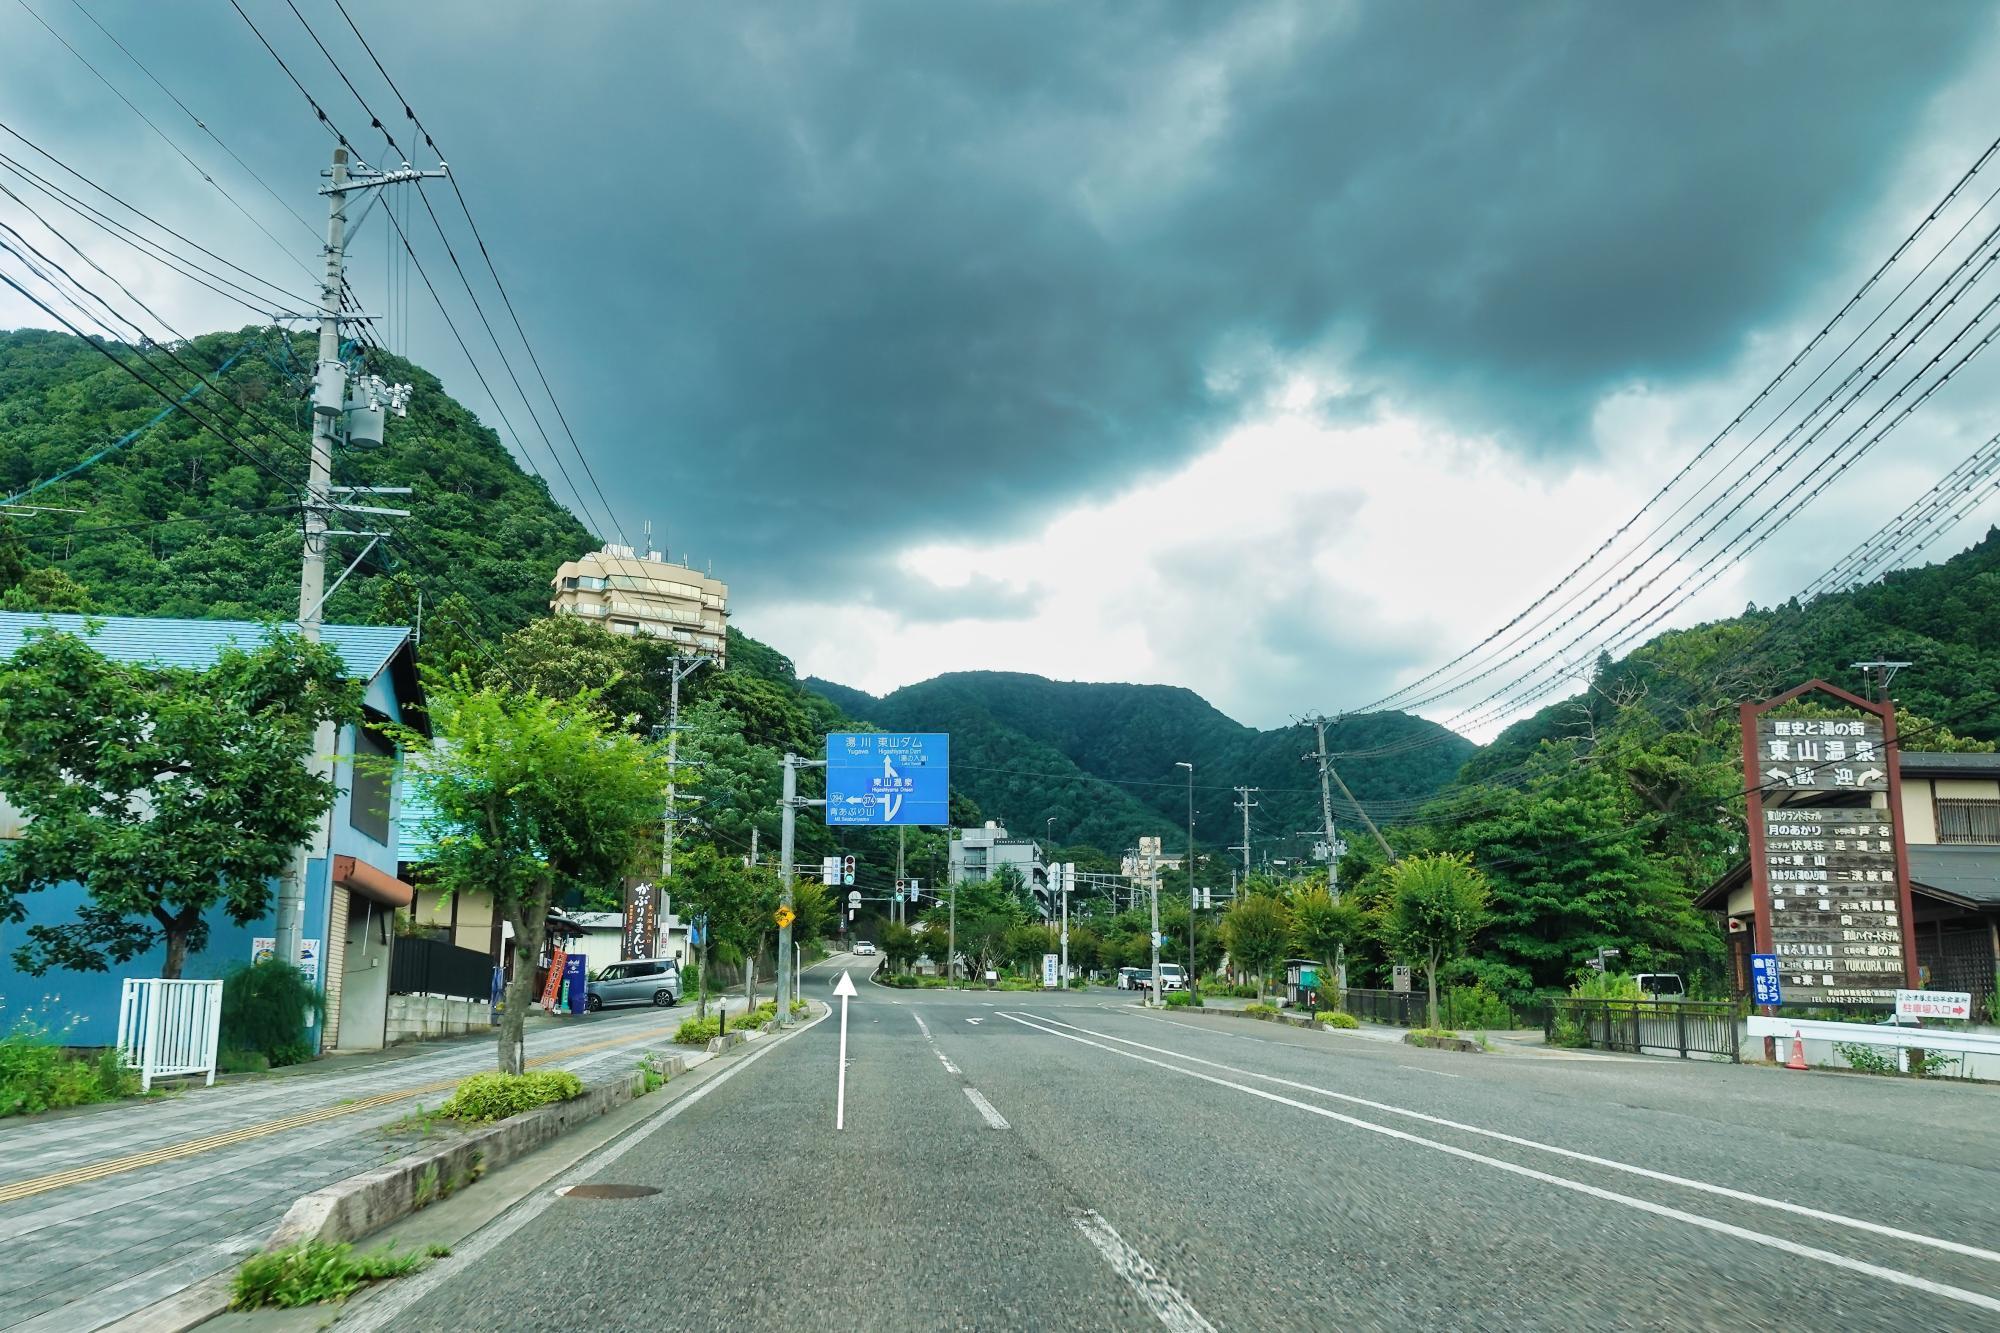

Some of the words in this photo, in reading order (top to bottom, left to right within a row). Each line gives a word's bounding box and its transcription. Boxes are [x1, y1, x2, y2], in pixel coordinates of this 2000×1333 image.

[1774, 721, 1865, 736] 歴史と湯の街
[877, 736, 923, 748] 東山ダム
[1767, 739, 1876, 761] 東山温泉
[873, 777, 913, 787] 東山温泉
[1795, 766, 1855, 786] 歓迎
[863, 795, 876, 805] 374
[1769, 824, 1822, 836] 月のあかり
[1844, 959, 1882, 972] YUKKURA
[1765, 958, 1779, 1002] 防犯カメラ
[1903, 1003, 1951, 1015] 駐車場入口
